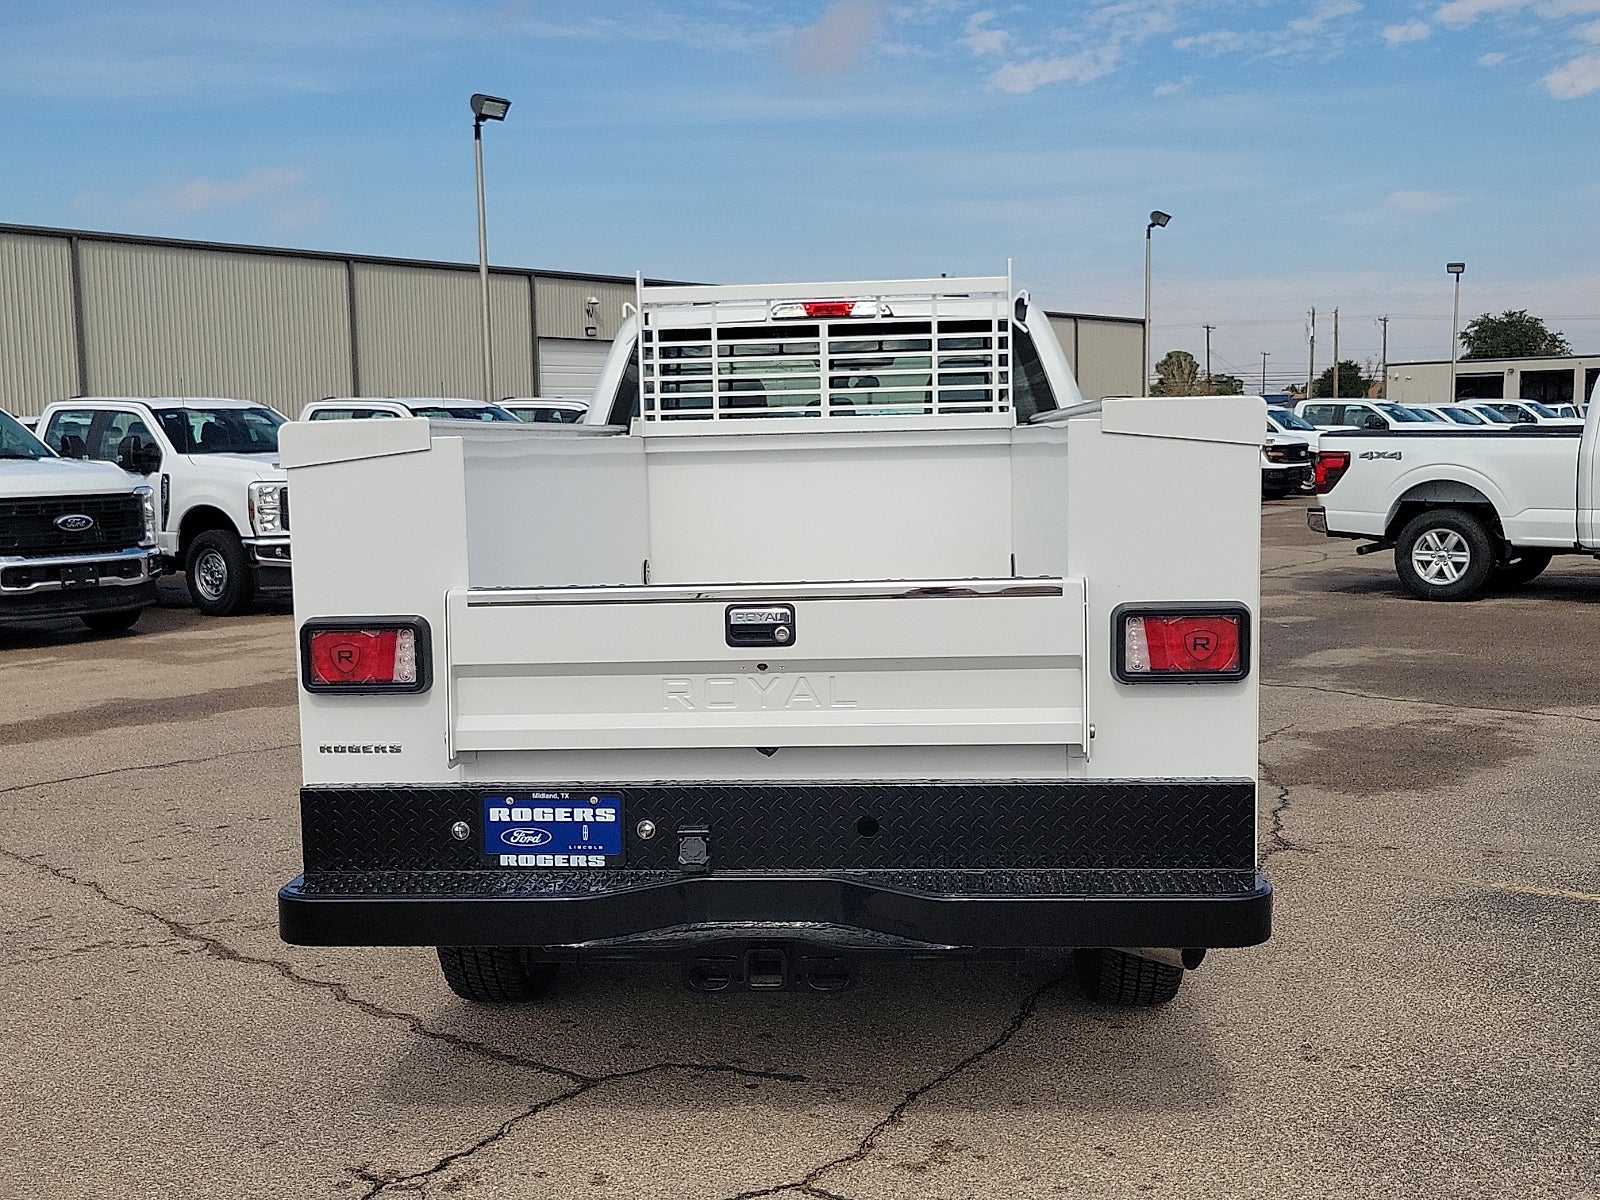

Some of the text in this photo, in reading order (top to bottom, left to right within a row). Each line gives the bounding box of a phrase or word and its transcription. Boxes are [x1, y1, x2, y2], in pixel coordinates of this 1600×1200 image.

[735, 612, 785, 622] ROYAL
[1193, 637, 1210, 650] R
[337, 650, 354, 664] R
[661, 675, 858, 709] ROYAL
[319, 744, 402, 754] ROGERS
[489, 808, 616, 822] ROGERS
[510, 829, 543, 844] Ford
[500, 855, 606, 867] ROGERS
